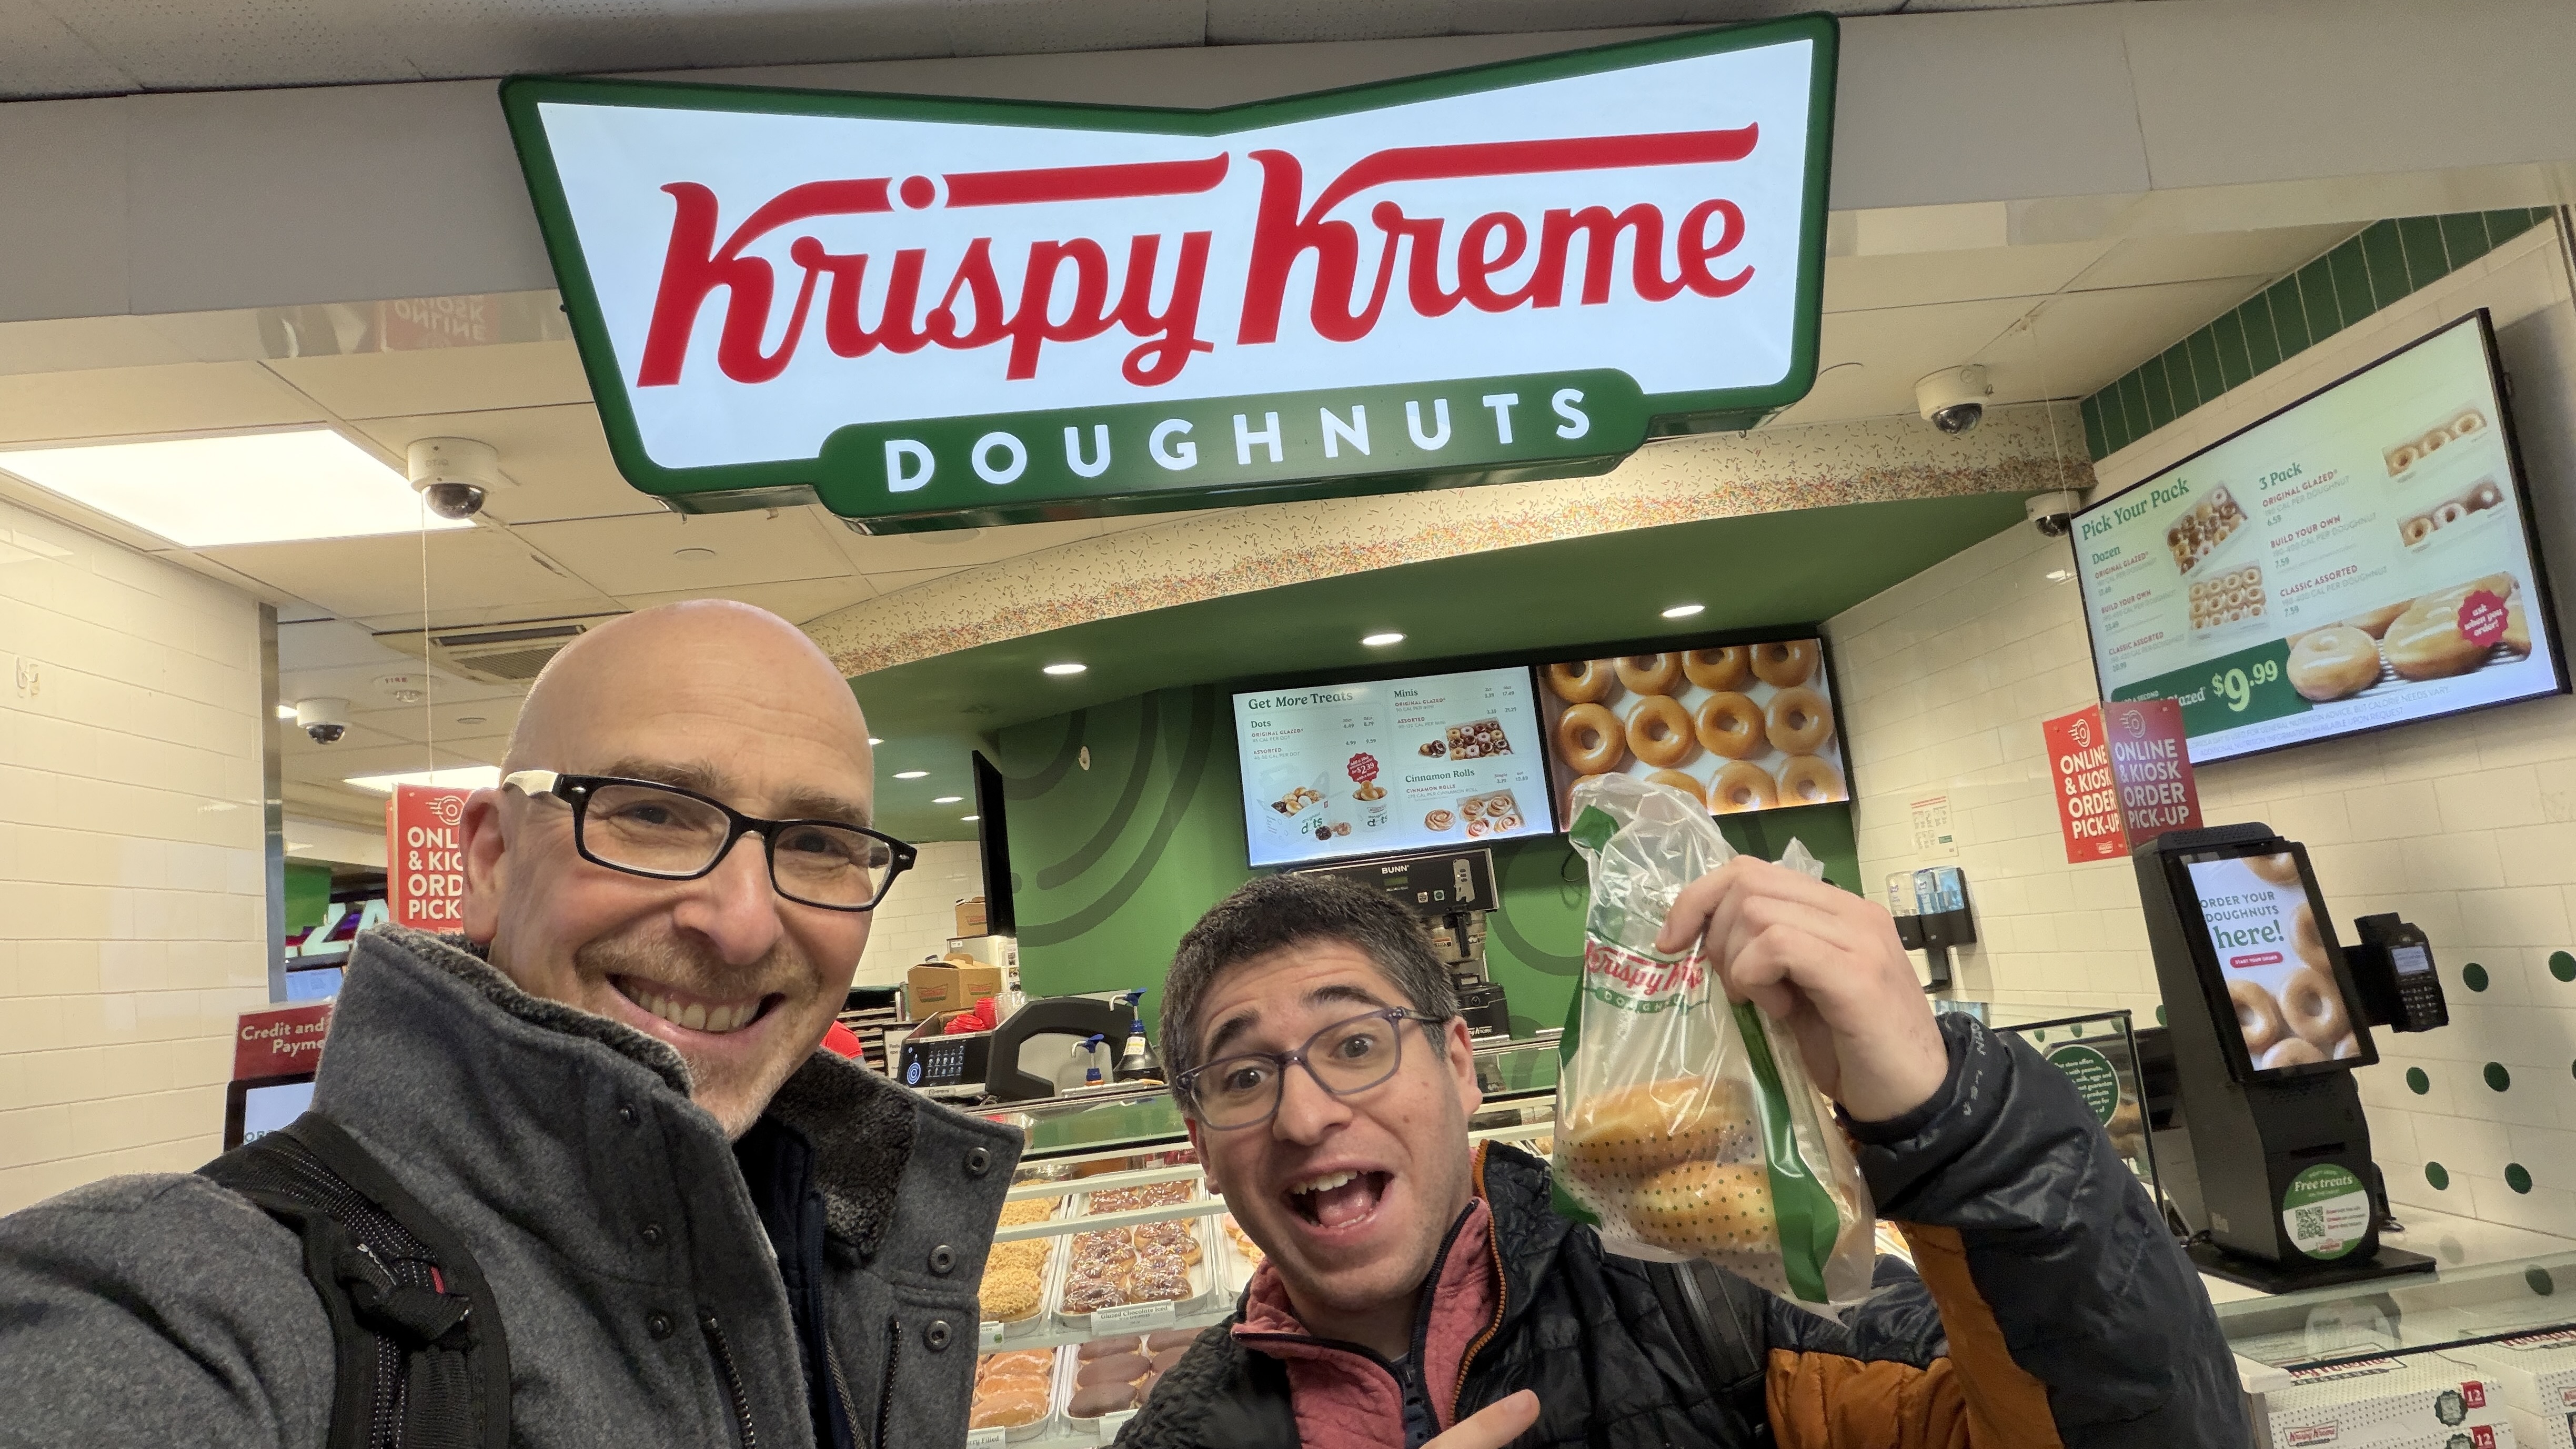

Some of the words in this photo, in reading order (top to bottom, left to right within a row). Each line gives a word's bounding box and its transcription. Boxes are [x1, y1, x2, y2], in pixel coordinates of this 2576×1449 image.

[636, 152, 1230, 388] Krispy
[1236, 122, 1759, 345] Kreme
[884, 387, 1592, 494] DOUGHNUTS
[2259, 476, 2268, 490] 3
[2270, 462, 2302, 486] Pack
[2263, 486, 2300, 507] ORIGINAL
[2082, 514, 2112, 541] Pick
[2114, 499, 2147, 525] Your
[2150, 477, 2189, 508] Pack
[2270, 534, 2293, 548] BUILD
[2295, 524, 2318, 538] YOUR
[2320, 515, 2340, 528] OWN
[2092, 546, 2121, 565] Dozen
[2095, 564, 2122, 579] ORIGINAL
[2279, 580, 2312, 597] CLASSIC
[2315, 565, 2358, 586] ASSORTED
[2101, 601, 2117, 613] BUILD
[2118, 596, 2135, 607] YOUR
[2137, 589, 2151, 600] OWN
[2472, 603, 2488, 616] ask
[2464, 616, 2486, 630] when
[2487, 609, 2503, 621] you
[2109, 642, 2132, 655] CLASSIC
[2133, 631, 2164, 647] ASSORTED
[1394, 689, 1418, 698] Minis
[2211, 660, 2279, 712] $9.99
[1248, 698, 1271, 710] Get
[1275, 695, 1308, 708] More
[1310, 692, 1353, 704] Treats
[2060, 744, 2107, 774] ONLINE
[2115, 738, 2178, 761] ONLINE
[1405, 772, 1451, 783] Cinnamon
[1453, 769, 1475, 778] Rolls
[2065, 777, 2077, 796] &
[2078, 767, 2112, 793] KIOSK
[2119, 763, 2129, 783] &
[2130, 760, 2182, 782] KIOSK
[2068, 790, 2117, 818] ORDER
[2124, 782, 2186, 808] ORDER
[2071, 812, 2120, 840] PICK-UP
[2128, 806, 2189, 829] PICK-UP
[407, 826, 458, 849] ONL
[408, 851, 422, 872] &
[428, 851, 463, 872] KIO
[408, 873, 463, 898] ORD
[408, 899, 461, 920] PICK
[2200, 894, 2240, 909] ORDER
[2241, 891, 2275, 904] YOUR
[2205, 905, 2279, 922] DOUGHNUTS
[2212, 919, 2285, 949] here!
[241, 1022, 291, 1040] Credit
[295, 1017, 325, 1035] and
[272, 1039, 325, 1058] Payme
[2295, 1180, 2318, 1192] Free
[2320, 1176, 2353, 1188] treats
[1123, 1308, 1153, 1316] Chocolate
[2467, 1390, 2482, 1402] 12
[981, 1435, 1000, 1444] Filled
[2477, 1433, 2493, 1446] 12
